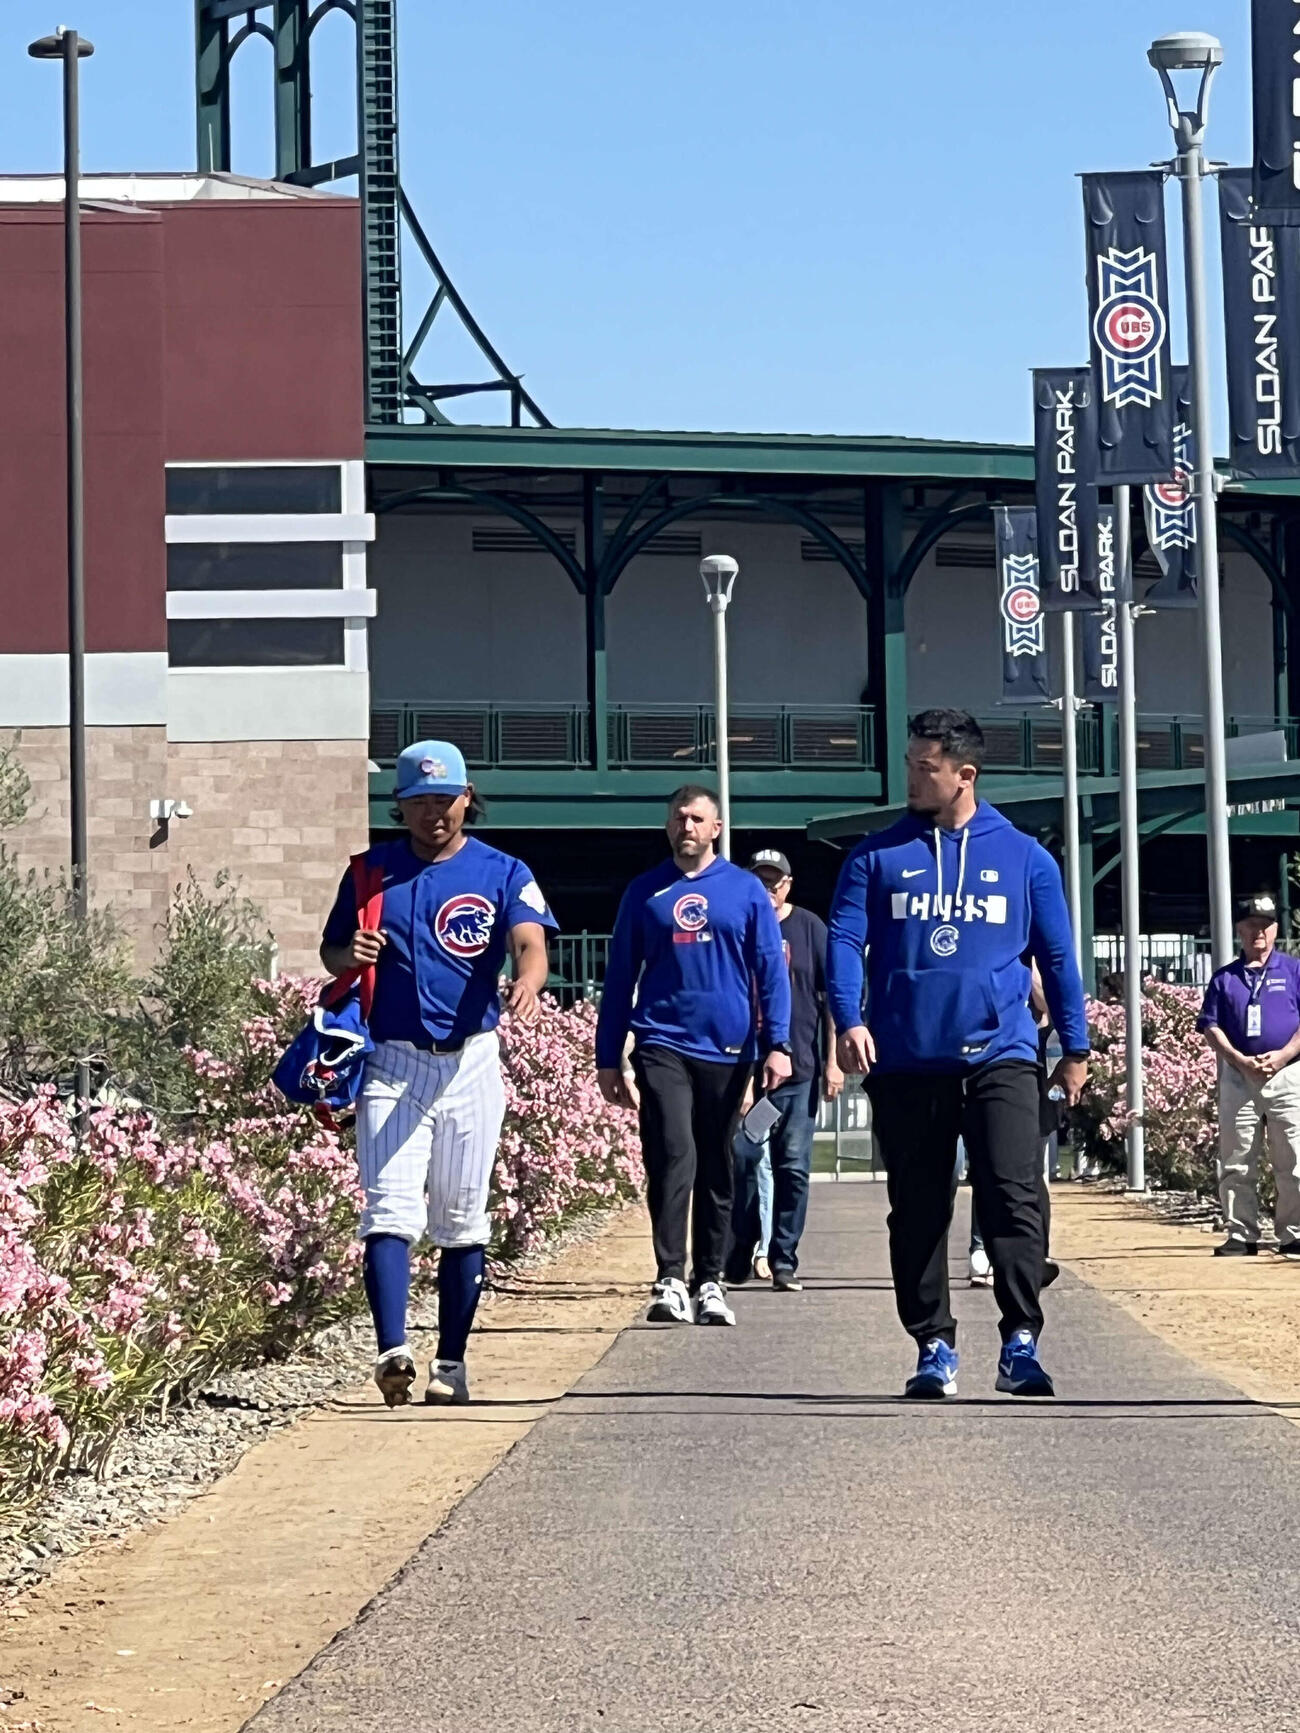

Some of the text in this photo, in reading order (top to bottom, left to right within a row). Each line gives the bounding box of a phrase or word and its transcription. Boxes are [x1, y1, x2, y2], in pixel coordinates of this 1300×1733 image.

[1108, 305, 1152, 350] CUBS
[1250, 196, 1281, 455] SLOAN PAR
[1055, 390, 1080, 593] SLOAN PARK
[1098, 524, 1116, 592] PARK
